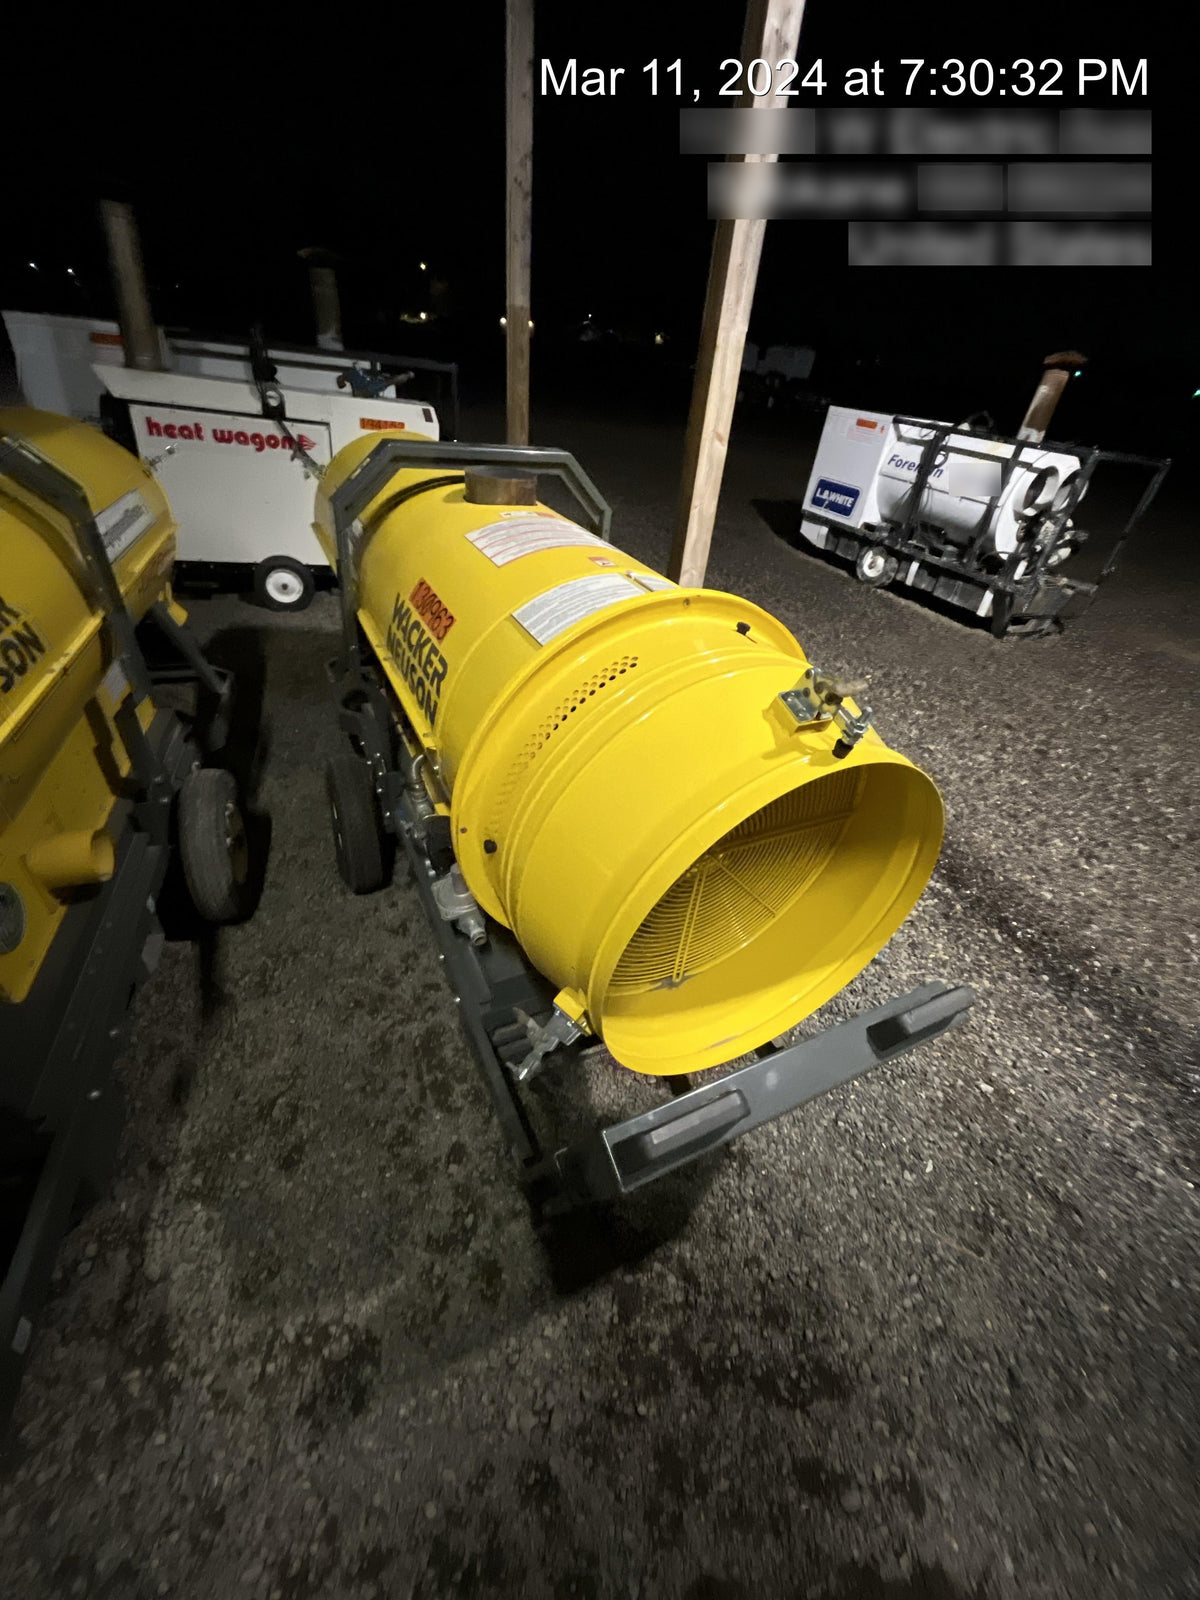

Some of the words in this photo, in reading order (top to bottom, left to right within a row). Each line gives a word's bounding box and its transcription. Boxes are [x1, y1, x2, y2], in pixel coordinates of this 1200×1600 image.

[146, 416, 205, 441] heat
[212, 428, 299, 452] wagon
[887, 454, 944, 478] Foren
[392, 592, 448, 698] WACKER
